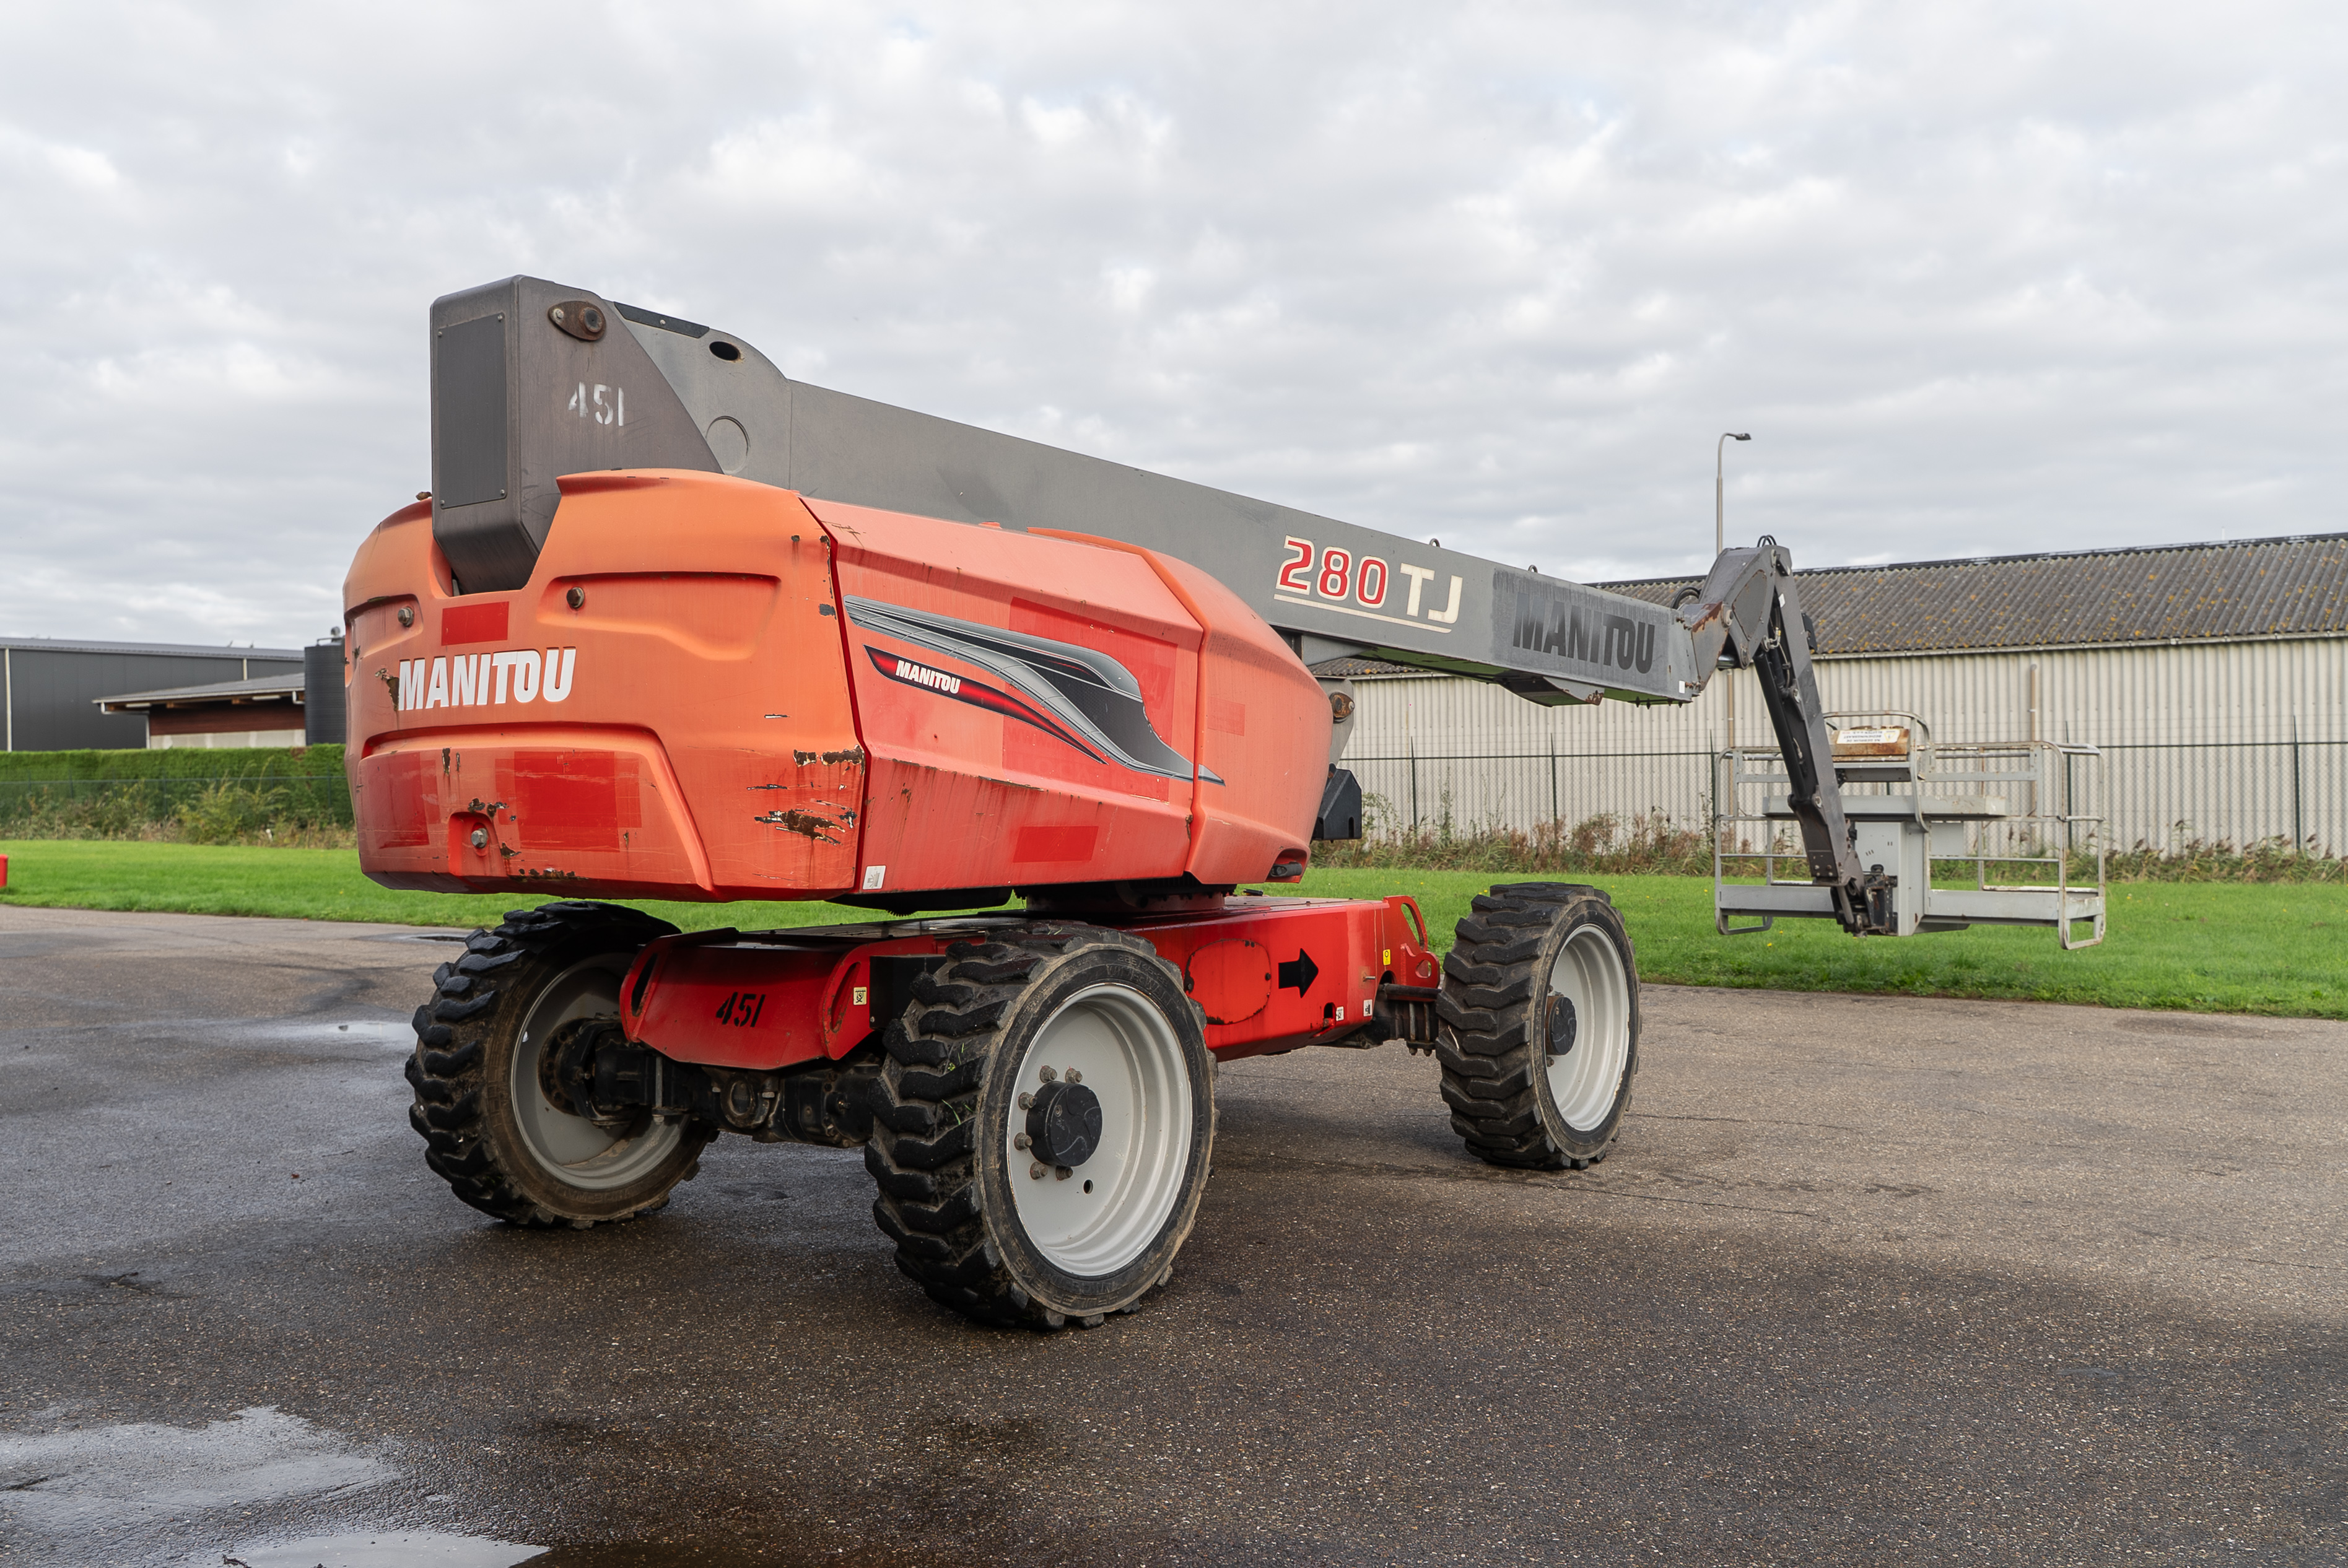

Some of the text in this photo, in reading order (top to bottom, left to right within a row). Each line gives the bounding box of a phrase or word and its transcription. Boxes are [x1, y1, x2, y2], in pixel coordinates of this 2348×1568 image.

[569, 381, 624, 427] 451
[1275, 534, 1464, 624] 280 TJ
[1512, 591, 1656, 674] MANITOU
[398, 648, 577, 711] MANITOU
[895, 660, 961, 694] MANITOU
[715, 991, 767, 1028] 451
